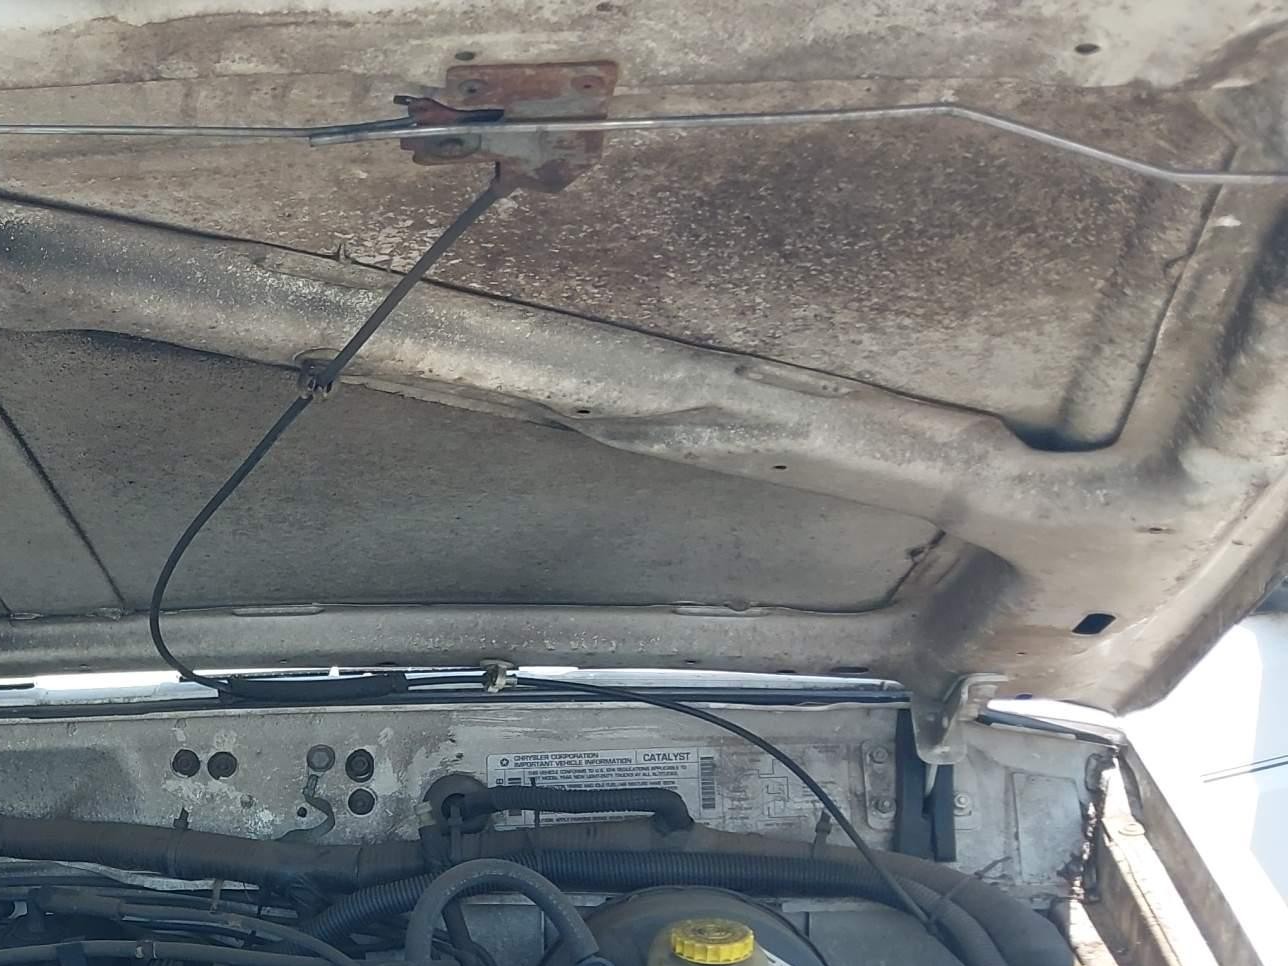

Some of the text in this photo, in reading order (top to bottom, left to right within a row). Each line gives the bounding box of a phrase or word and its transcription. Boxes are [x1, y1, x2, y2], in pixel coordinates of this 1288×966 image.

[513, 752, 600, 762] CHRYSLER CORPORATION
[553, 759, 585, 767] VEHICLE
[585, 757, 632, 766] INFORMATION
[642, 752, 691, 762] CATALYST
